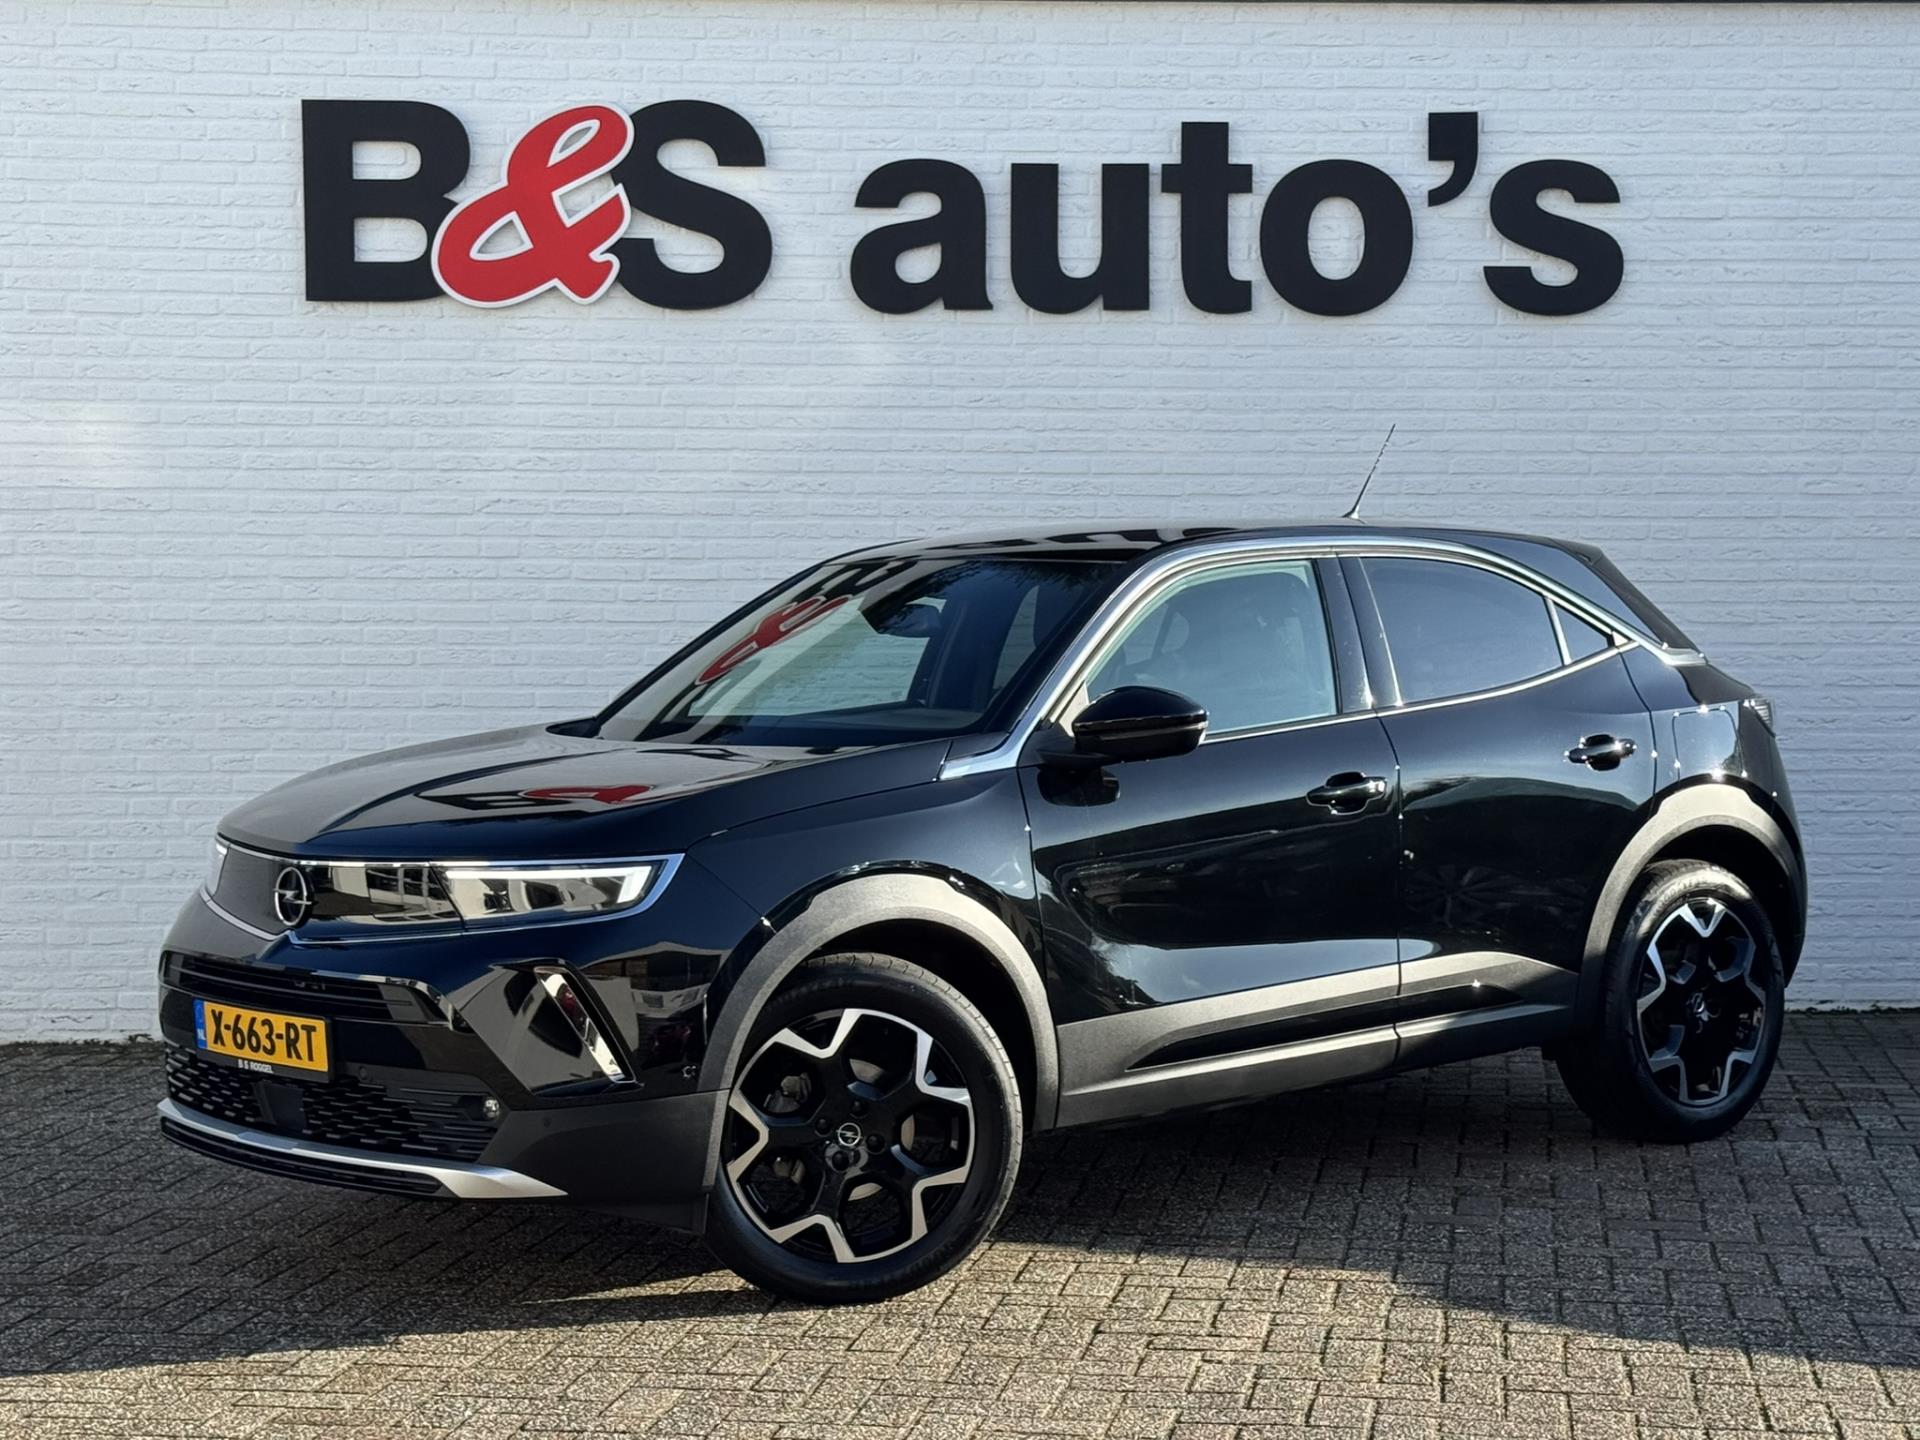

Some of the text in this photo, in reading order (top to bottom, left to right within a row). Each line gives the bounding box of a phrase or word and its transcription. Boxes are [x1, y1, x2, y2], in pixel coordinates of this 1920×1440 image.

[302, 99, 1624, 316] B&S auto's
[211, 1009, 316, 1061] X-663-RT
